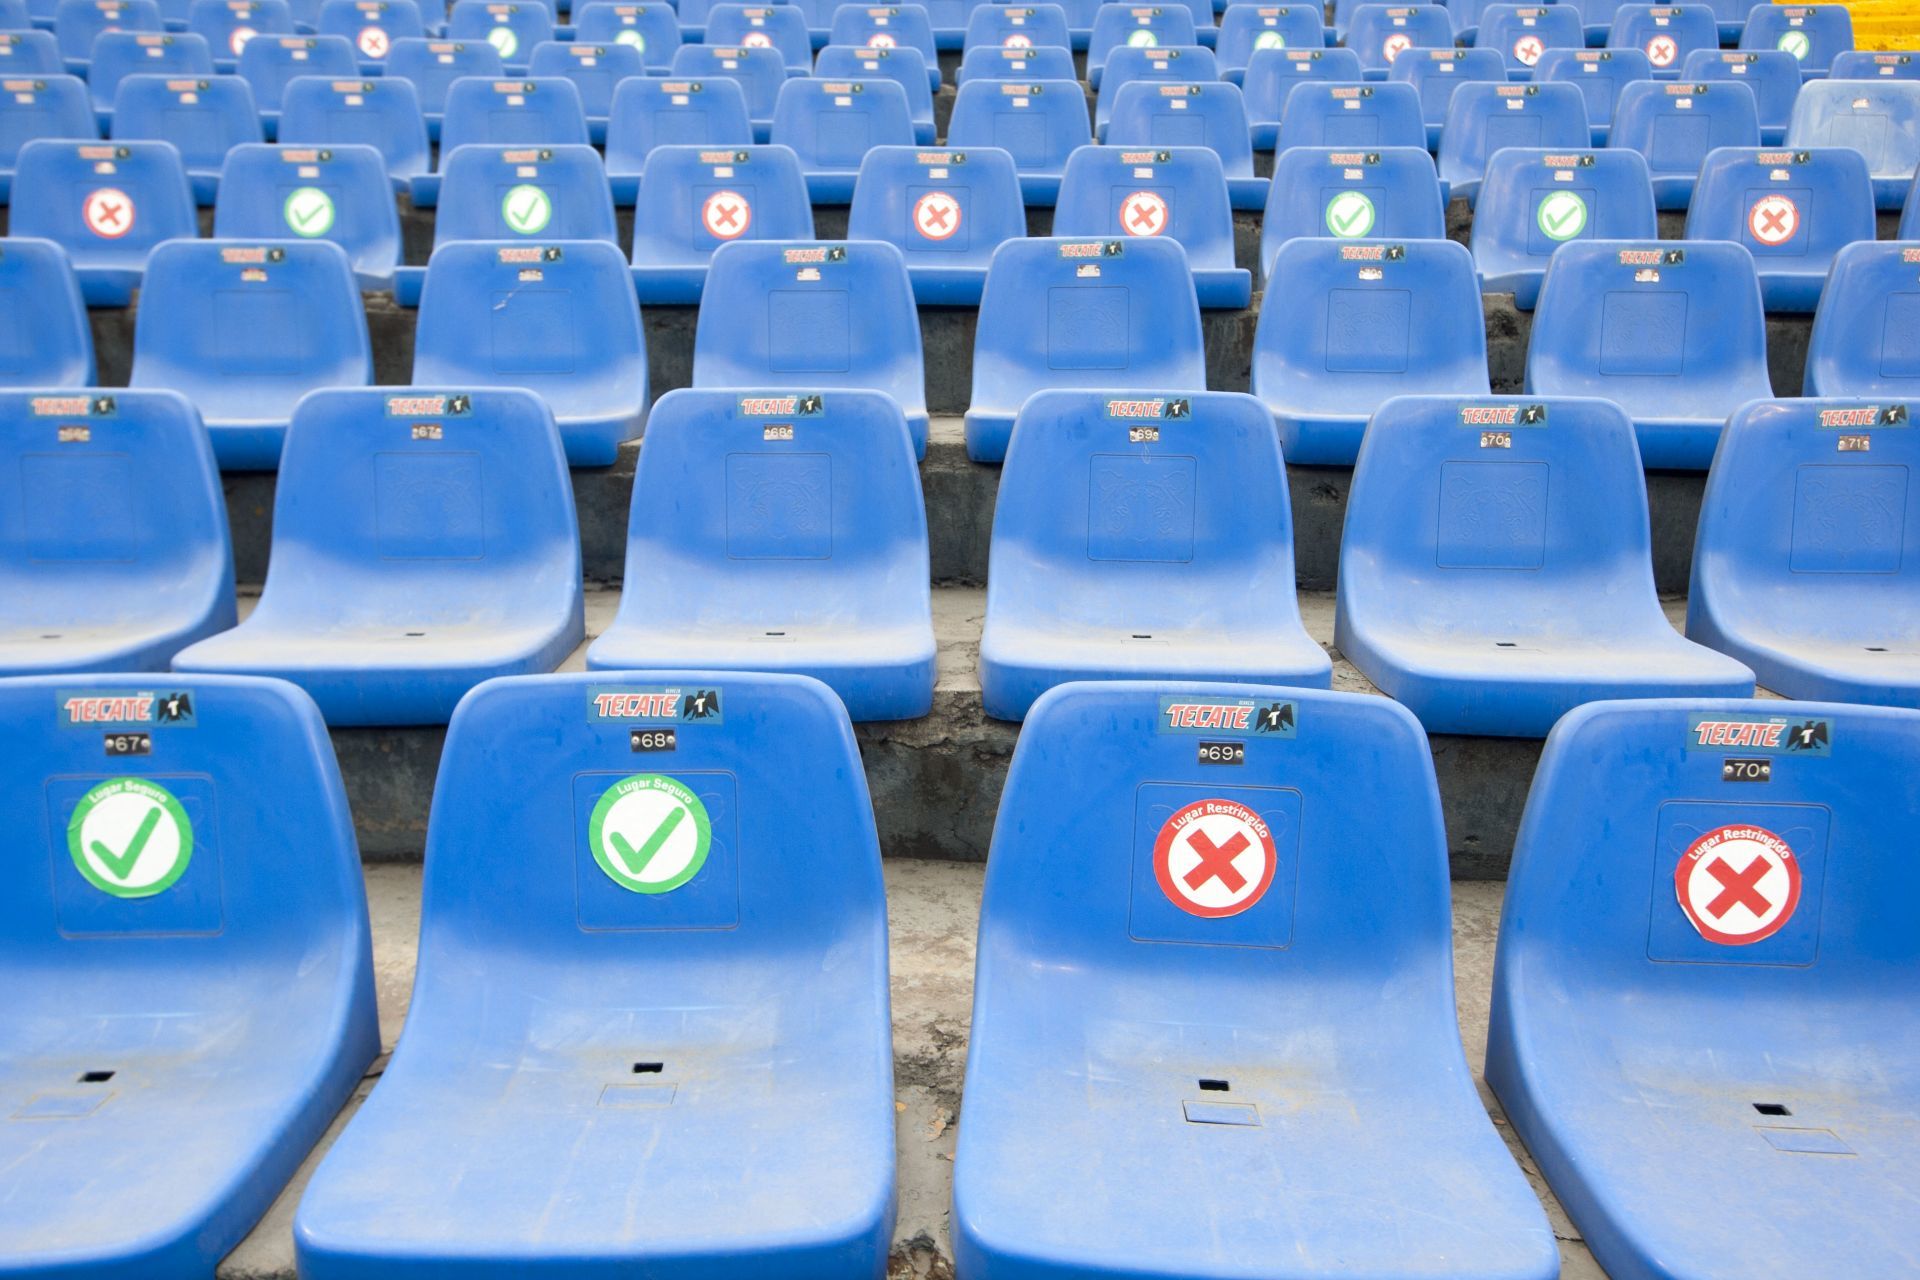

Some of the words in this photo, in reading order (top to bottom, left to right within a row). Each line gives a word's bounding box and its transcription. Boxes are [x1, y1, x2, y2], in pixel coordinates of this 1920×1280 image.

[388, 397, 445, 416] TECATE
[741, 398, 797, 415] TECATE
[1107, 400, 1165, 418] TECATE
[1461, 407, 1518, 424] TECATE
[1819, 408, 1879, 427] TECATE
[418, 425, 435, 438] 67
[770, 427, 787, 438] 68
[1137, 428, 1153, 440] 69
[1487, 434, 1505, 446] 70
[1848, 437, 1861, 449] 71
[64, 696, 154, 723] TECATE
[593, 692, 681, 718] TECATE
[1165, 703, 1255, 730] TECATE
[641, 732, 666, 748] 68
[1694, 721, 1788, 747] TECATE
[115, 736, 141, 752] 67
[1208, 746, 1234, 761] 69
[1734, 763, 1761, 778] 70
[87, 783, 123, 804] Lugar
[124, 780, 168, 803] Seguro
[616, 779, 651, 796] Lugar
[653, 777, 693, 804] Seguro
[1171, 807, 1204, 831] Lugar
[1206, 803, 1268, 839] Restringido
[1688, 834, 1721, 861] Lugar
[1723, 828, 1791, 860] Restringido
